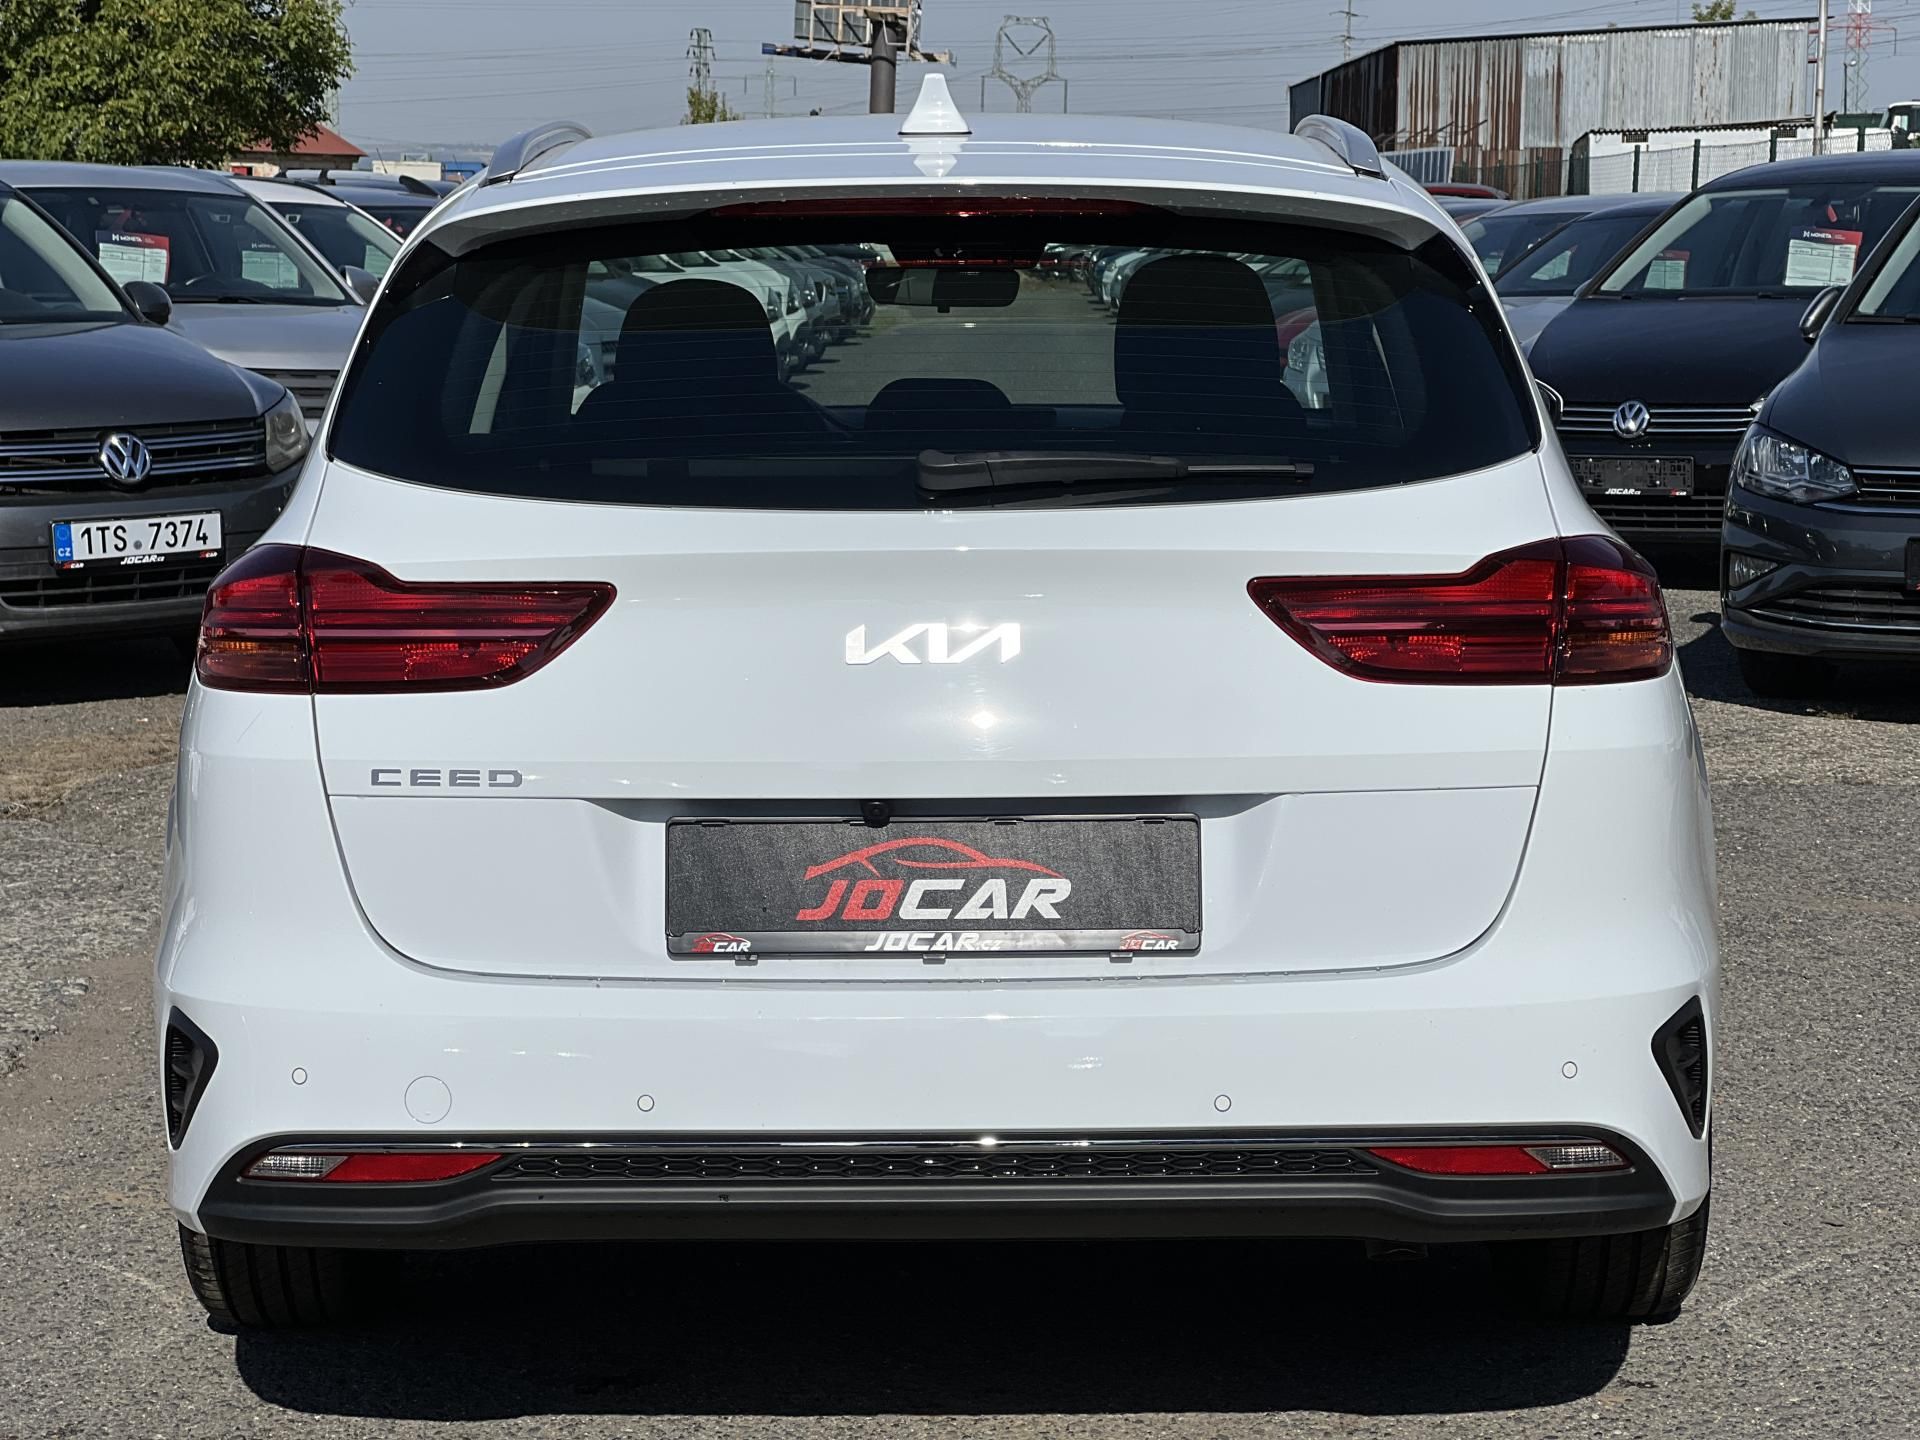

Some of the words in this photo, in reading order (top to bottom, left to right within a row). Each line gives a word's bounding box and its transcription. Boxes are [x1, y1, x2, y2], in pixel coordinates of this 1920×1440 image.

[101, 432, 152, 484] VW
[57, 547, 71, 557] CZ
[81, 525, 127, 555] 1TS
[148, 518, 208, 550] 7374
[846, 622, 1021, 665] KIA
[371, 769, 523, 788] CEED
[796, 878, 1072, 921] JOCAR
